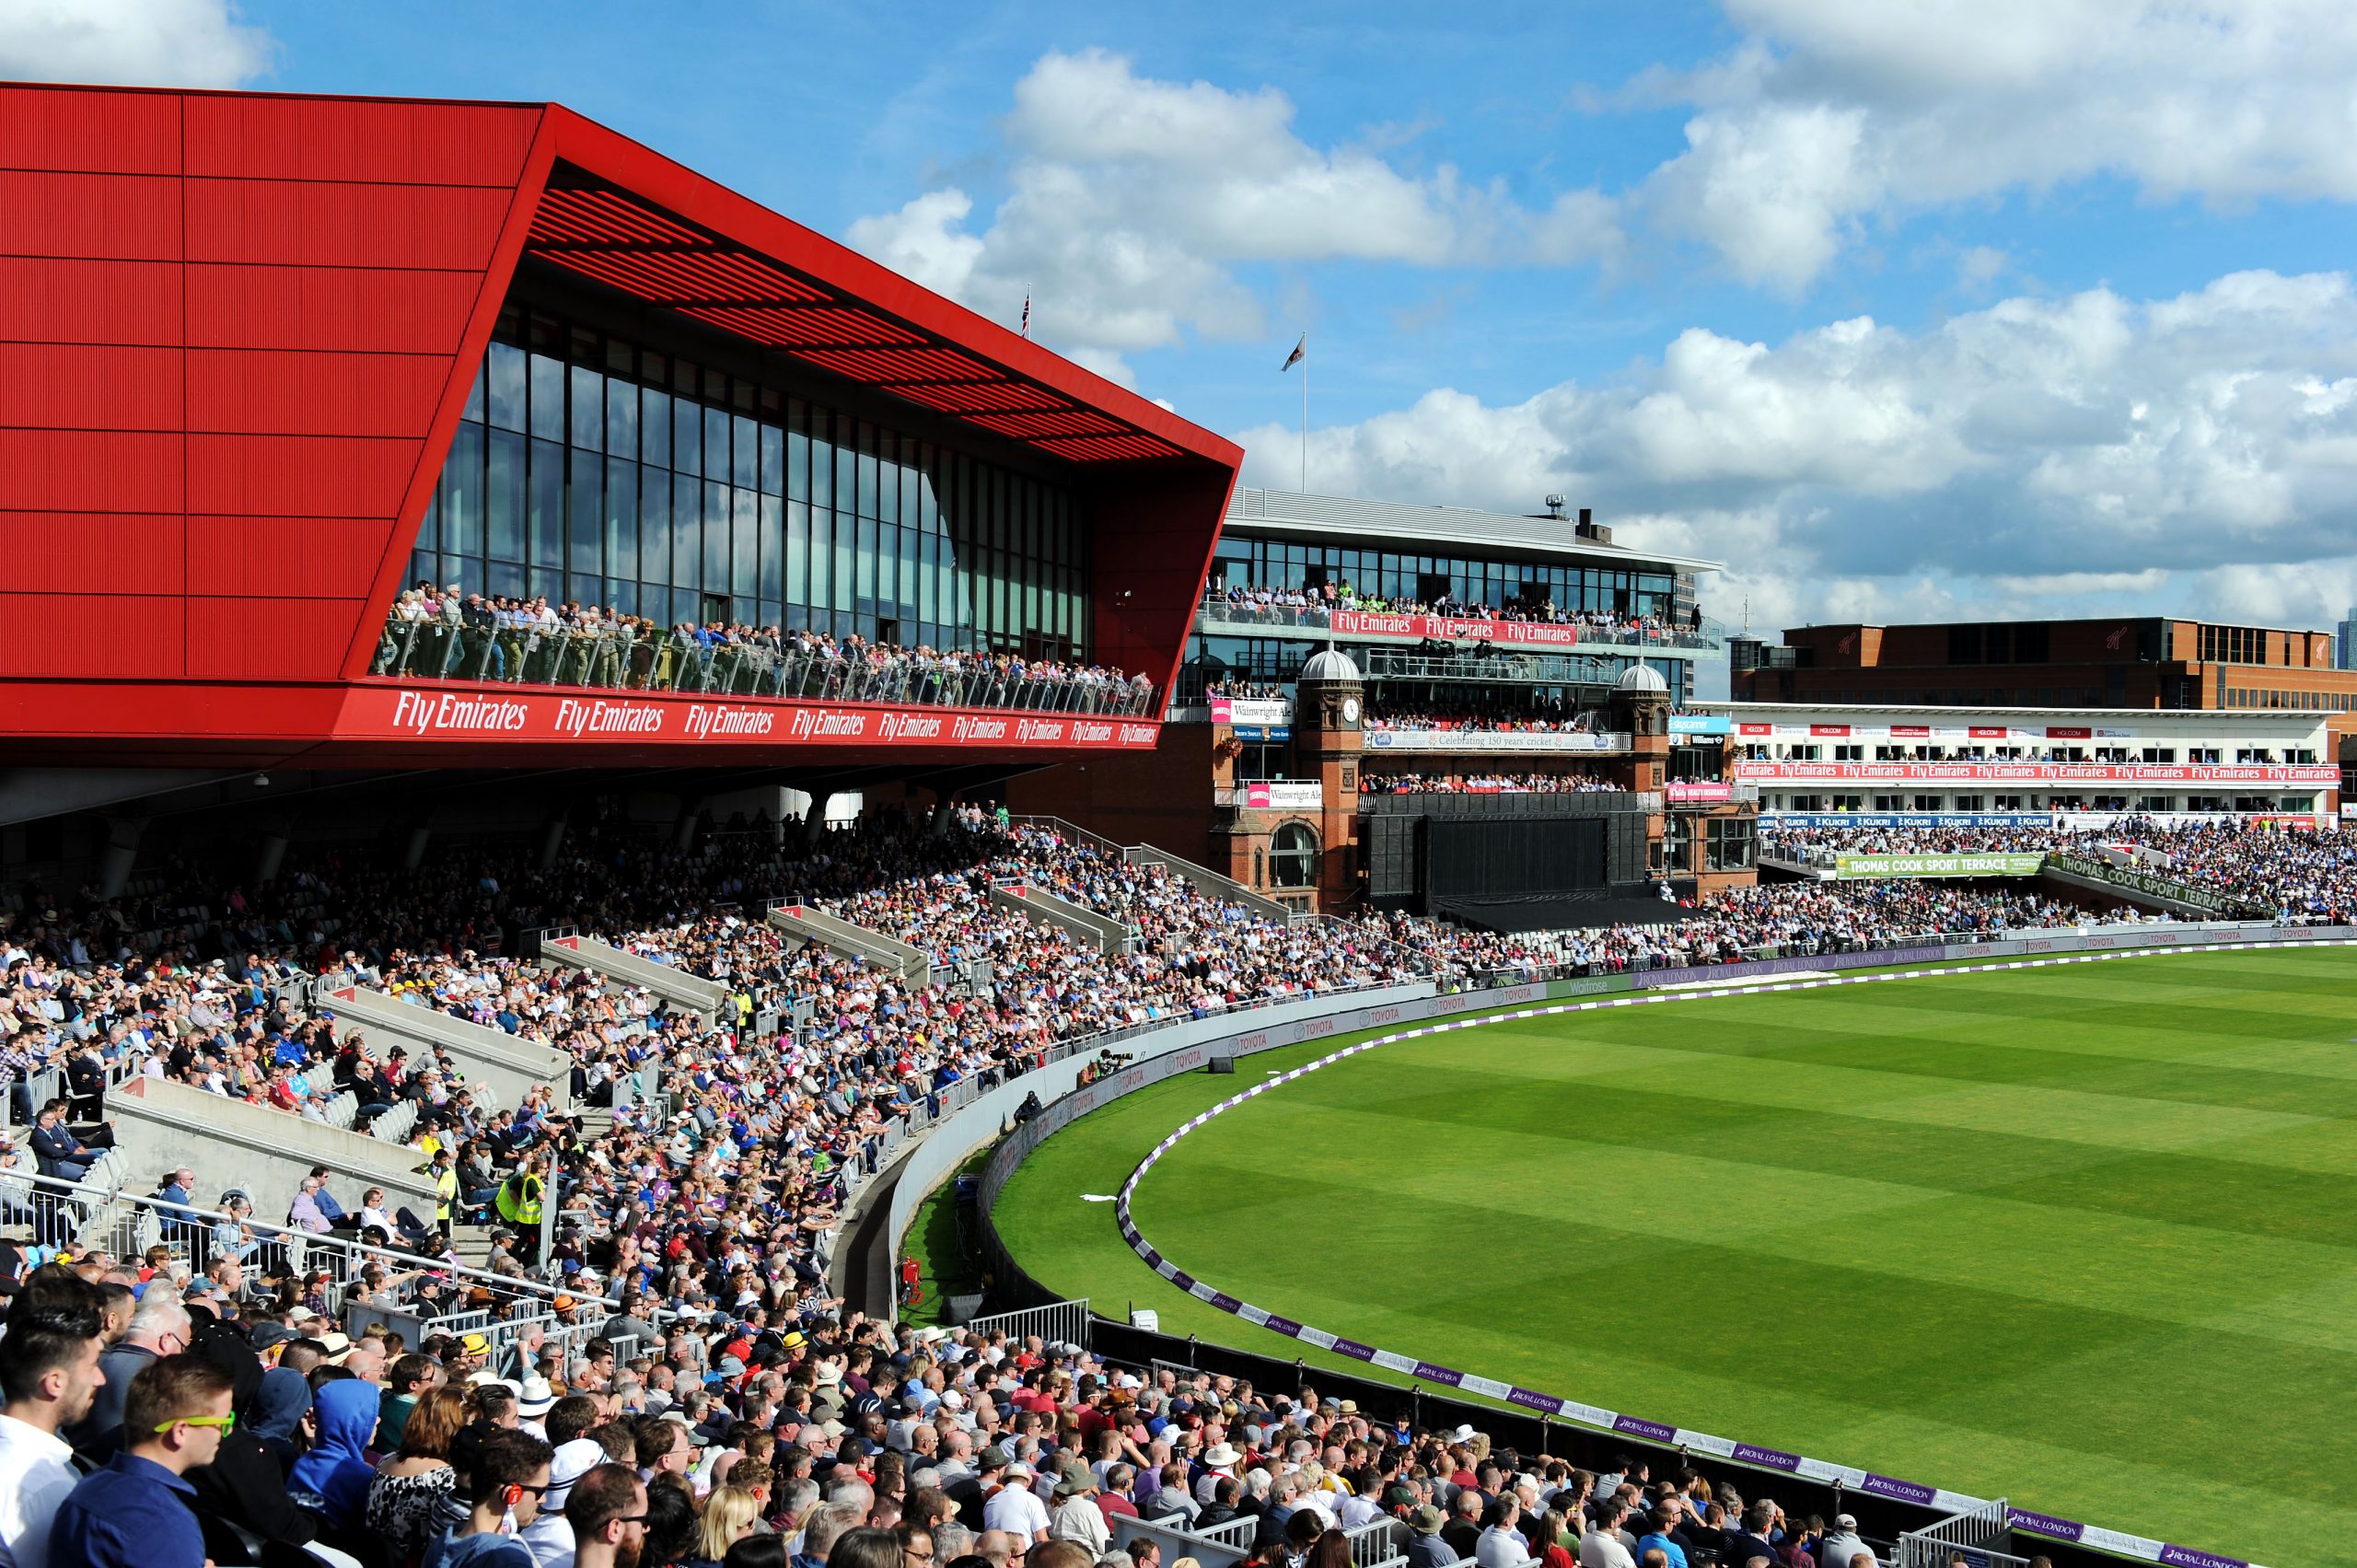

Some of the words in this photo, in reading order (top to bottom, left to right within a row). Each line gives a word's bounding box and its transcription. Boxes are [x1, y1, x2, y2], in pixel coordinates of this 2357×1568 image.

[1338, 613, 1358, 633] Fly
[1361, 614, 1411, 633] Emirates
[1426, 618, 1446, 637] Fly
[1447, 620, 1493, 638] Emirates
[1507, 622, 1526, 642] Fly
[1527, 624, 1571, 643] Emirates
[392, 691, 435, 735] Fly
[435, 694, 528, 730] Emirates
[554, 700, 591, 738] Fly
[587, 701, 664, 733] Emirates
[1235, 705, 1277, 720] Wainwright
[1279, 706, 1291, 717] Ale
[684, 705, 714, 739] Fly
[712, 705, 774, 734] Emirates
[790, 709, 817, 740] Fly
[813, 710, 866, 736] Emirates
[877, 713, 900, 741] Fly
[897, 714, 942, 738] Emirates
[951, 716, 971, 743] Fly
[967, 716, 1007, 739] Emirates
[1015, 719, 1034, 744] Fly
[1028, 719, 1063, 741] Emirates
[1070, 721, 1086, 744] Fly
[1081, 722, 1113, 743] Emirates
[1117, 724, 1131, 745] Fly
[1127, 724, 1157, 744] Emirates
[1439, 735, 1484, 748] Celebrating
[1488, 736, 1502, 745] 150
[1527, 736, 1551, 746] cricket
[1692, 736, 1713, 744] Williams
[1741, 765, 1775, 776] Emirates
[1781, 765, 1794, 778] Fly
[1794, 765, 1836, 776] Emirates
[1843, 765, 1860, 778] Fly
[1862, 765, 1904, 776] Emirates
[1910, 765, 1926, 778] Fly
[1928, 765, 1970, 777] Emirates
[1977, 766, 1992, 778] Fly
[1994, 766, 2035, 777] Emirates
[2041, 766, 2058, 779] Fly
[2060, 766, 2107, 778] Emirates
[2115, 767, 2134, 779] Fly
[2136, 767, 2184, 778] Emirates
[2191, 767, 2210, 780] Fly
[2212, 767, 2260, 779] Emirates
[2268, 768, 2286, 781] Fly
[2289, 768, 2335, 779] Emirates
[1271, 789, 1309, 803] Wainwright
[1310, 790, 1321, 799] Ale
[1822, 818, 1850, 827] KUKRI
[1863, 818, 1890, 827] KUKRI
[1904, 818, 1931, 826] KUKRI
[1945, 818, 1970, 826] KUKRI
[1984, 818, 2011, 826] KUKRI
[2023, 817, 2049, 826] KUKRI
[1850, 861, 1889, 874] THOMAS
[1893, 860, 1923, 873] COOK
[1927, 859, 1958, 872] SPORT
[1961, 858, 2006, 871] TERRACE
[2061, 856, 2105, 878] THOMAS
[2107, 869, 2140, 889] COOK
[2144, 879, 2180, 900] SPORT
[2184, 889, 2232, 911] TERRAC
[2151, 934, 2177, 943] TOYOTA
[2214, 932, 2240, 941] TOYOTA
[2283, 930, 2313, 938] TOYOTA
[2027, 941, 2051, 951] TOYOTA
[2088, 937, 2114, 947] TOYOTA
[1897, 951, 1916, 962] ROYAL
[1916, 948, 1942, 959] LONDON
[1966, 946, 1990, 955] TOYOTA
[1777, 960, 1796, 971] ROYAL
[1797, 958, 1825, 970] LONDON
[1838, 956, 1857, 967] ROYAL
[1857, 953, 1884, 965] LONDON
[1643, 973, 1665, 984] ROYAL
[1666, 970, 1696, 982] LONDON
[1712, 967, 1733, 978] ROYAL
[1735, 964, 1762, 976] LONDON
[1571, 980, 1608, 993] Waitrose
[1504, 988, 1532, 1000] TOYOTA
[1438, 997, 1466, 1011] TOYOTA
[1371, 1009, 1399, 1023] TOYOTA
[1306, 1019, 1333, 1036] TOYOTA
[1239, 1033, 1267, 1051] TOYOTA
[1175, 1050, 1202, 1068] TOYOTA
[1122, 1070, 1144, 1086] TOYOTA
[657, 1185, 665, 1196] 6
[1422, 1367, 1437, 1376] ROYAL
[1438, 1372, 1457, 1382] LONDON
[1515, 1391, 1533, 1402] ROYAL
[1534, 1397, 1558, 1409] LONDON
[1624, 1420, 1643, 1431] ROYAL
[1643, 1425, 1670, 1437] LONDON
[1744, 1448, 1764, 1460] ROYAL
[1765, 1453, 1794, 1466] LONDON
[1874, 1480, 1896, 1492] ROYAL
[1897, 1484, 1930, 1499] LONDON
[2016, 1514, 2040, 1527] ROYAL
[2042, 1522, 2077, 1538] LONDON
[2174, 1551, 2200, 1564] ROYAL
